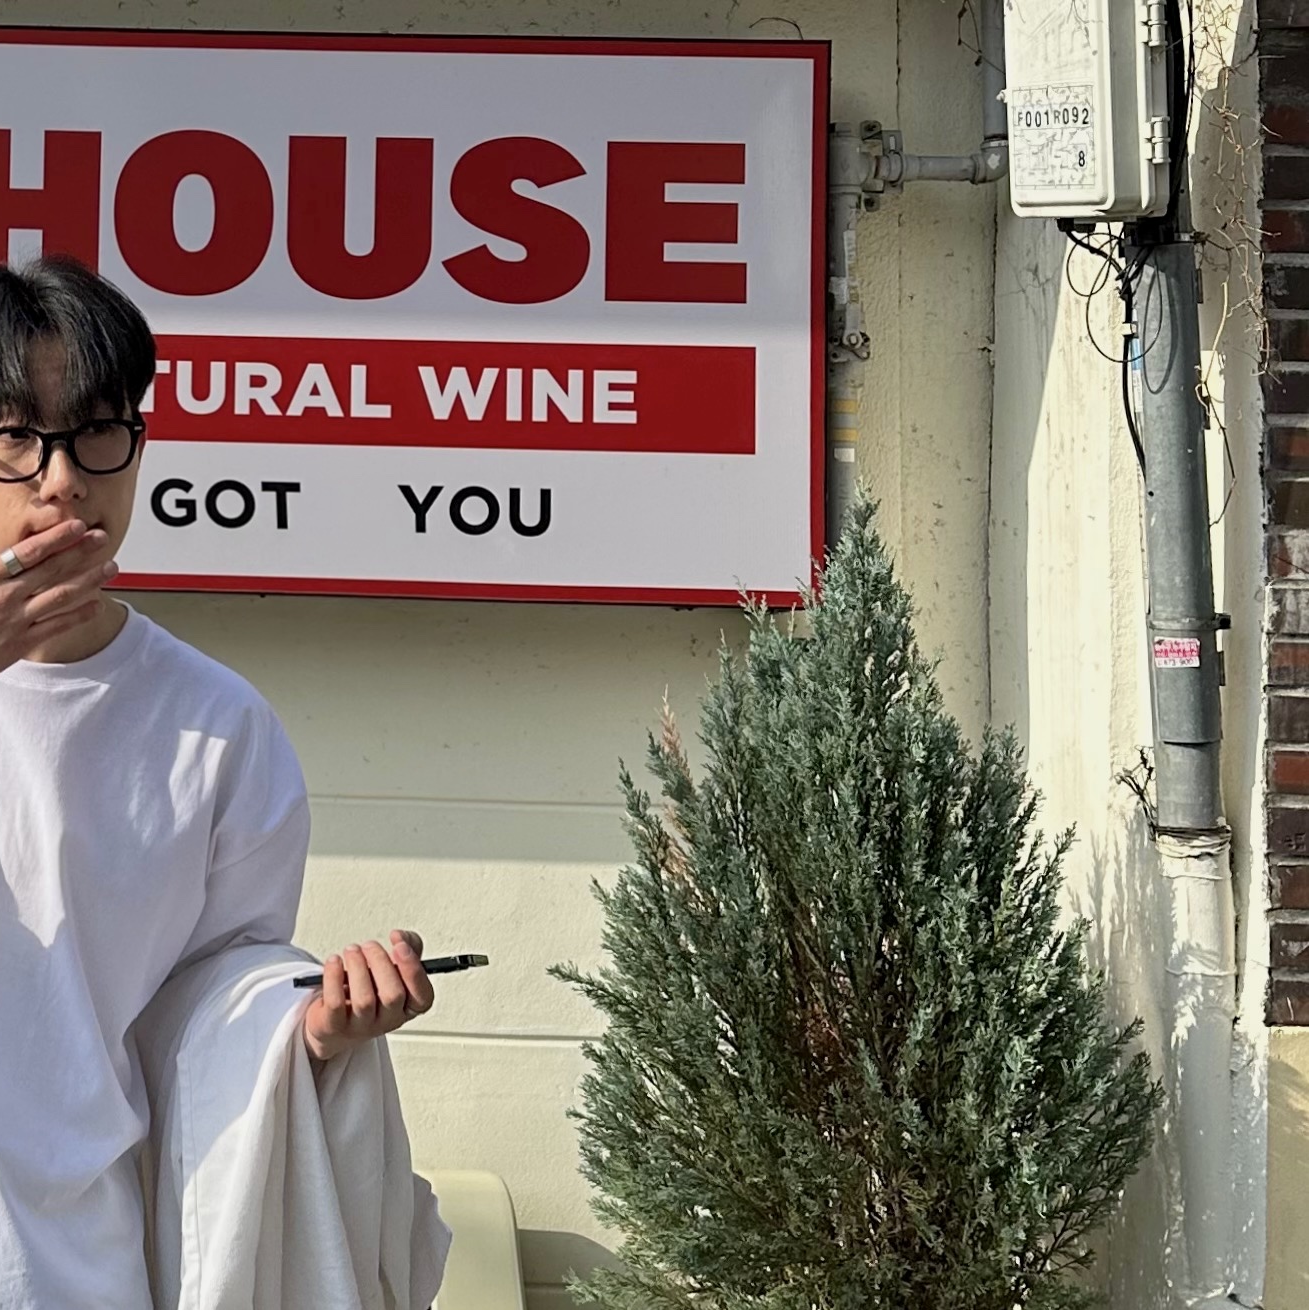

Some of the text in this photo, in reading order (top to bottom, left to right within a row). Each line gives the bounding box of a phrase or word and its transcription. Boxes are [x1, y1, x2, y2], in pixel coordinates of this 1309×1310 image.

[1078, 150, 1086, 167] 8
[418, 366, 638, 424] WINE
[150, 478, 301, 530] GOT
[397, 484, 552, 537] YOU
